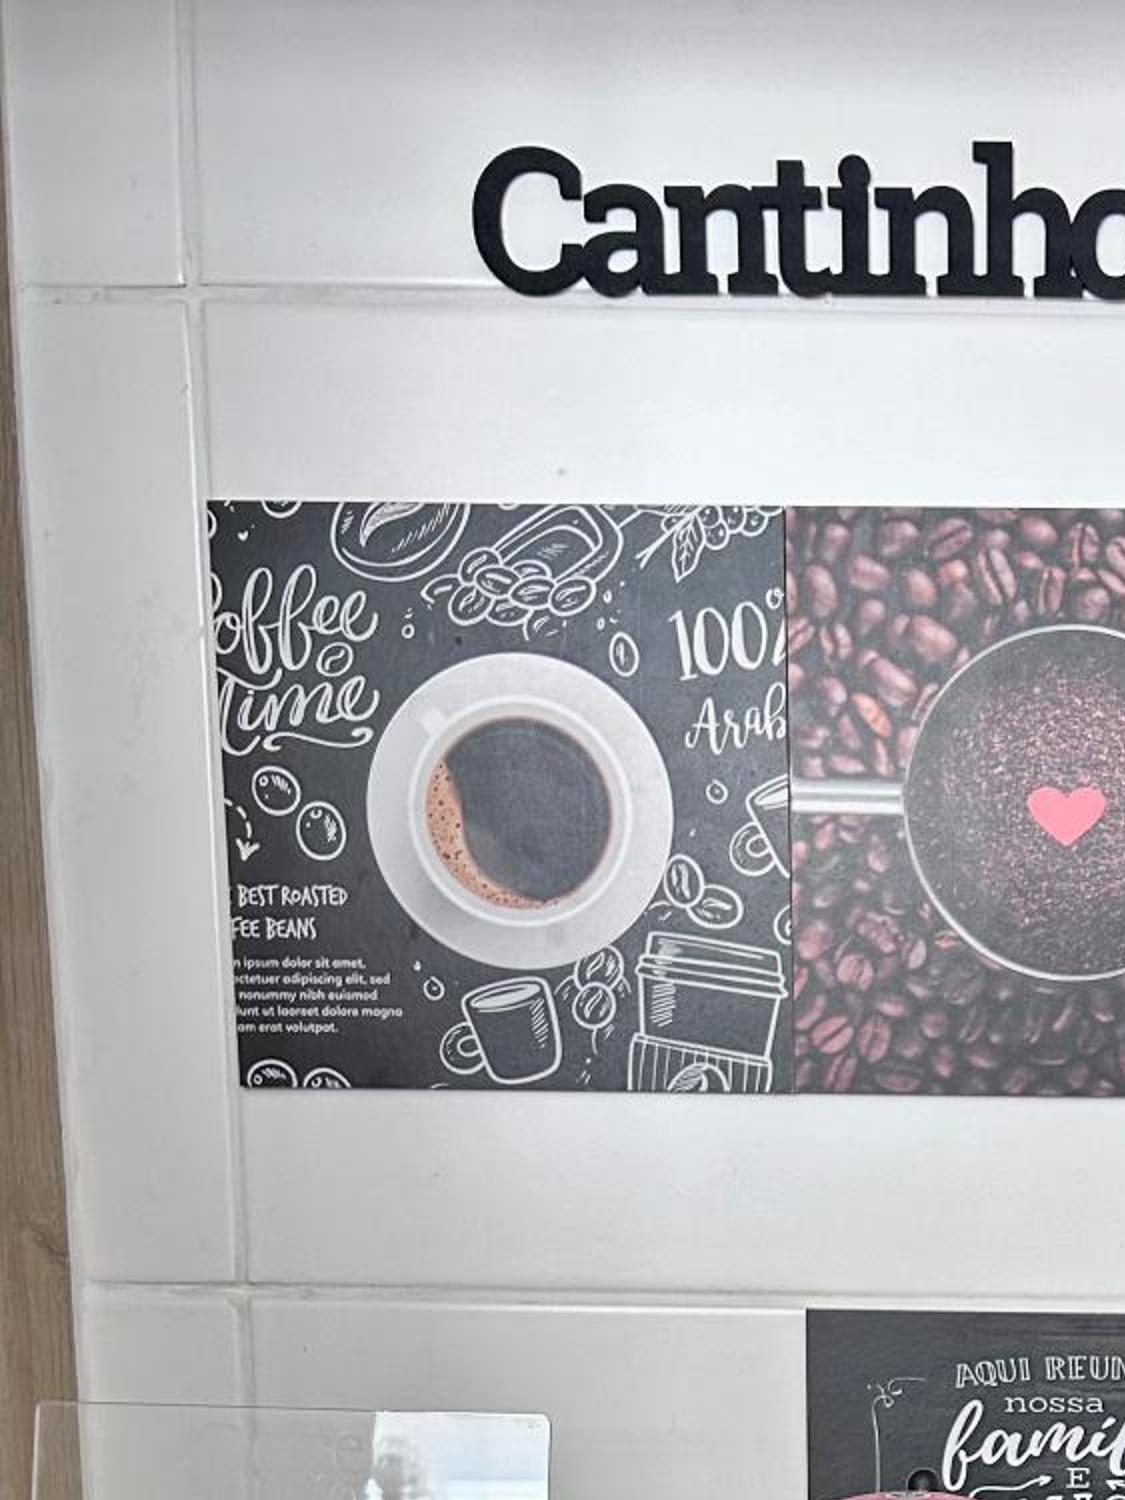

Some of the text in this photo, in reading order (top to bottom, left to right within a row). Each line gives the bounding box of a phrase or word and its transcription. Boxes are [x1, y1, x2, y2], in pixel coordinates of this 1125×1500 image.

[211, 564, 378, 674] offee
[237, 884, 348, 908] BEST ROASTED
[265, 916, 317, 940] BEANS
[243, 956, 279, 970] ipsum
[282, 956, 312, 968] dolor
[315, 955, 330, 968] sit
[369, 971, 390, 985] sed
[300, 988, 326, 1000] nibh
[322, 1005, 359, 1017] dolore
[361, 1007, 403, 1020] magna
[955, 1357, 1031, 1389] AQUI
[1004, 1396, 1105, 1413] nossa
[1066, 1467, 1090, 1489] E
